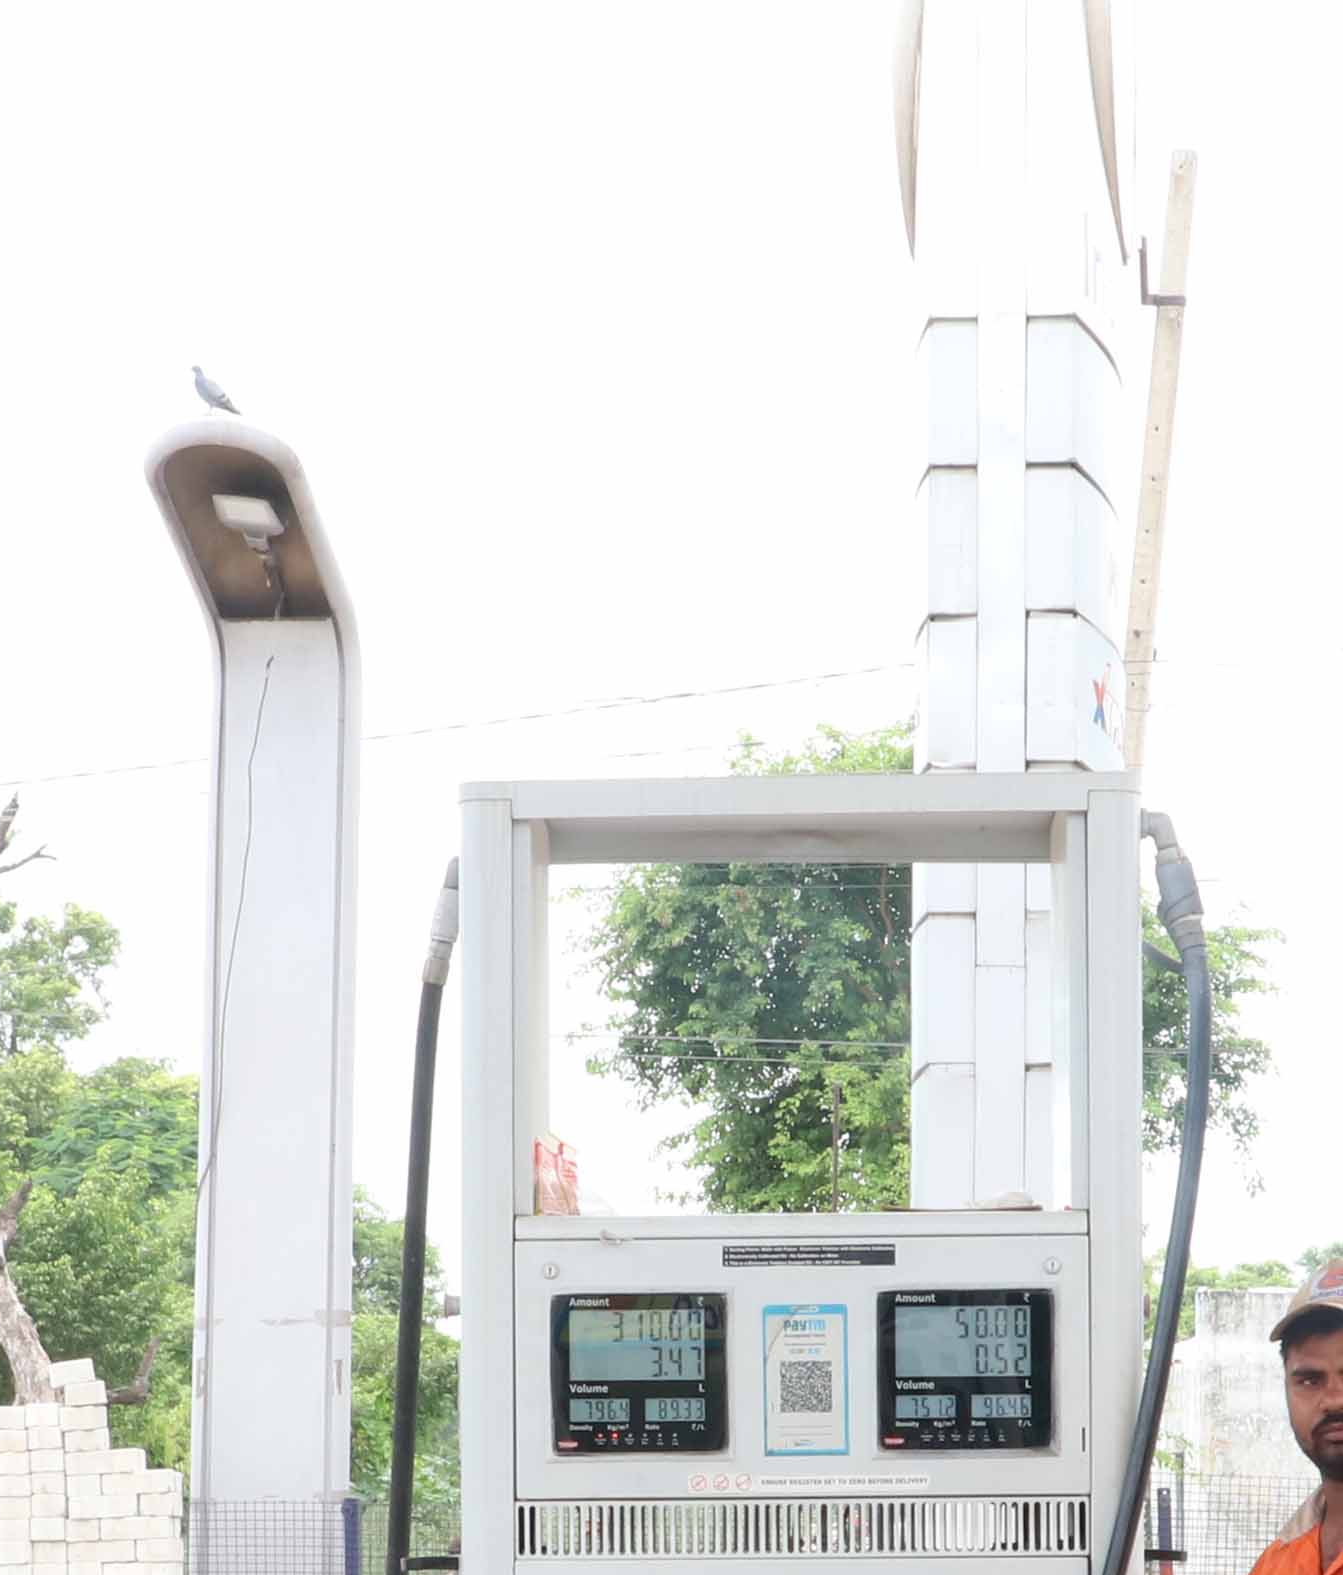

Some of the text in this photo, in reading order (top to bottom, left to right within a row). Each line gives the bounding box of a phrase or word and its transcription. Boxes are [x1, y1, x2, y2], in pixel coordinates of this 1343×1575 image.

[569, 1297, 610, 1307] Amount
[895, 1294, 936, 1303] Amount
[956, 1308, 1027, 1338] 50.00
[650, 1347, 702, 1377] 3.47
[975, 1344, 1027, 1374] 0.52
[569, 1384, 608, 1393] Volume
[895, 1380, 935, 1390] Volume
